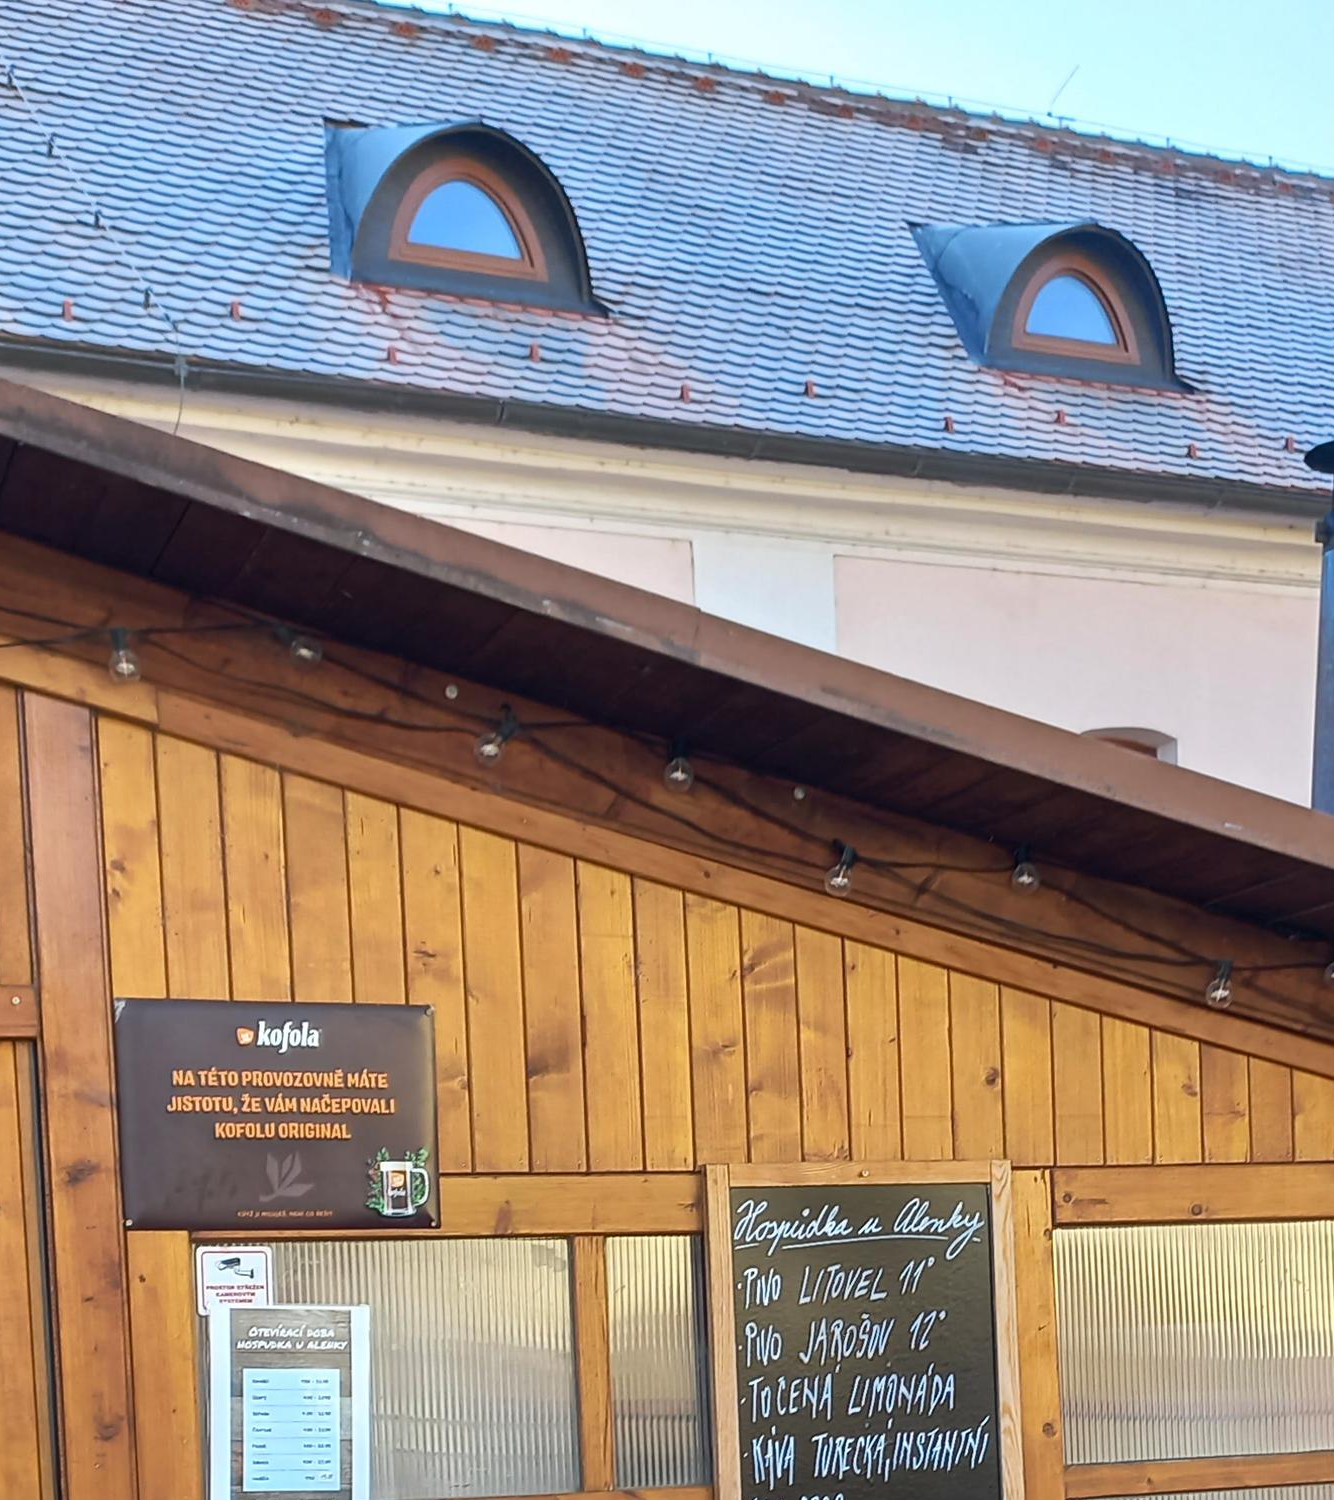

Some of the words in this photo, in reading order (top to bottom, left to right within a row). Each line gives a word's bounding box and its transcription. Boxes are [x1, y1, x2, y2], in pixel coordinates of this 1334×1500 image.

[256, 1020, 320, 1054] kofola
[172, 1069, 195, 1087] NA
[197, 1066, 239, 1087] TÉTO
[241, 1068, 345, 1088] PROVOZOVNĚ
[347, 1068, 389, 1089] MÁTE
[166, 1095, 239, 1115] JISTOTU,
[241, 1093, 262, 1113] ŽE
[264, 1092, 297, 1113] VÁM
[300, 1093, 396, 1114] NAČEPOVALI
[214, 1121, 276, 1139] KOFOLU
[278, 1122, 352, 1139] ORIGINAL
[893, 1197, 986, 1261] Alenky
[744, 1266, 782, 1310] PIVO
[798, 1263, 888, 1306] LITOVEL
[745, 1320, 783, 1368] PIVO
[798, 1313, 896, 1367] JAROŠOV
[847, 1363, 955, 1418] LIMONÁDA
[752, 1425, 796, 1491] KÁVA
